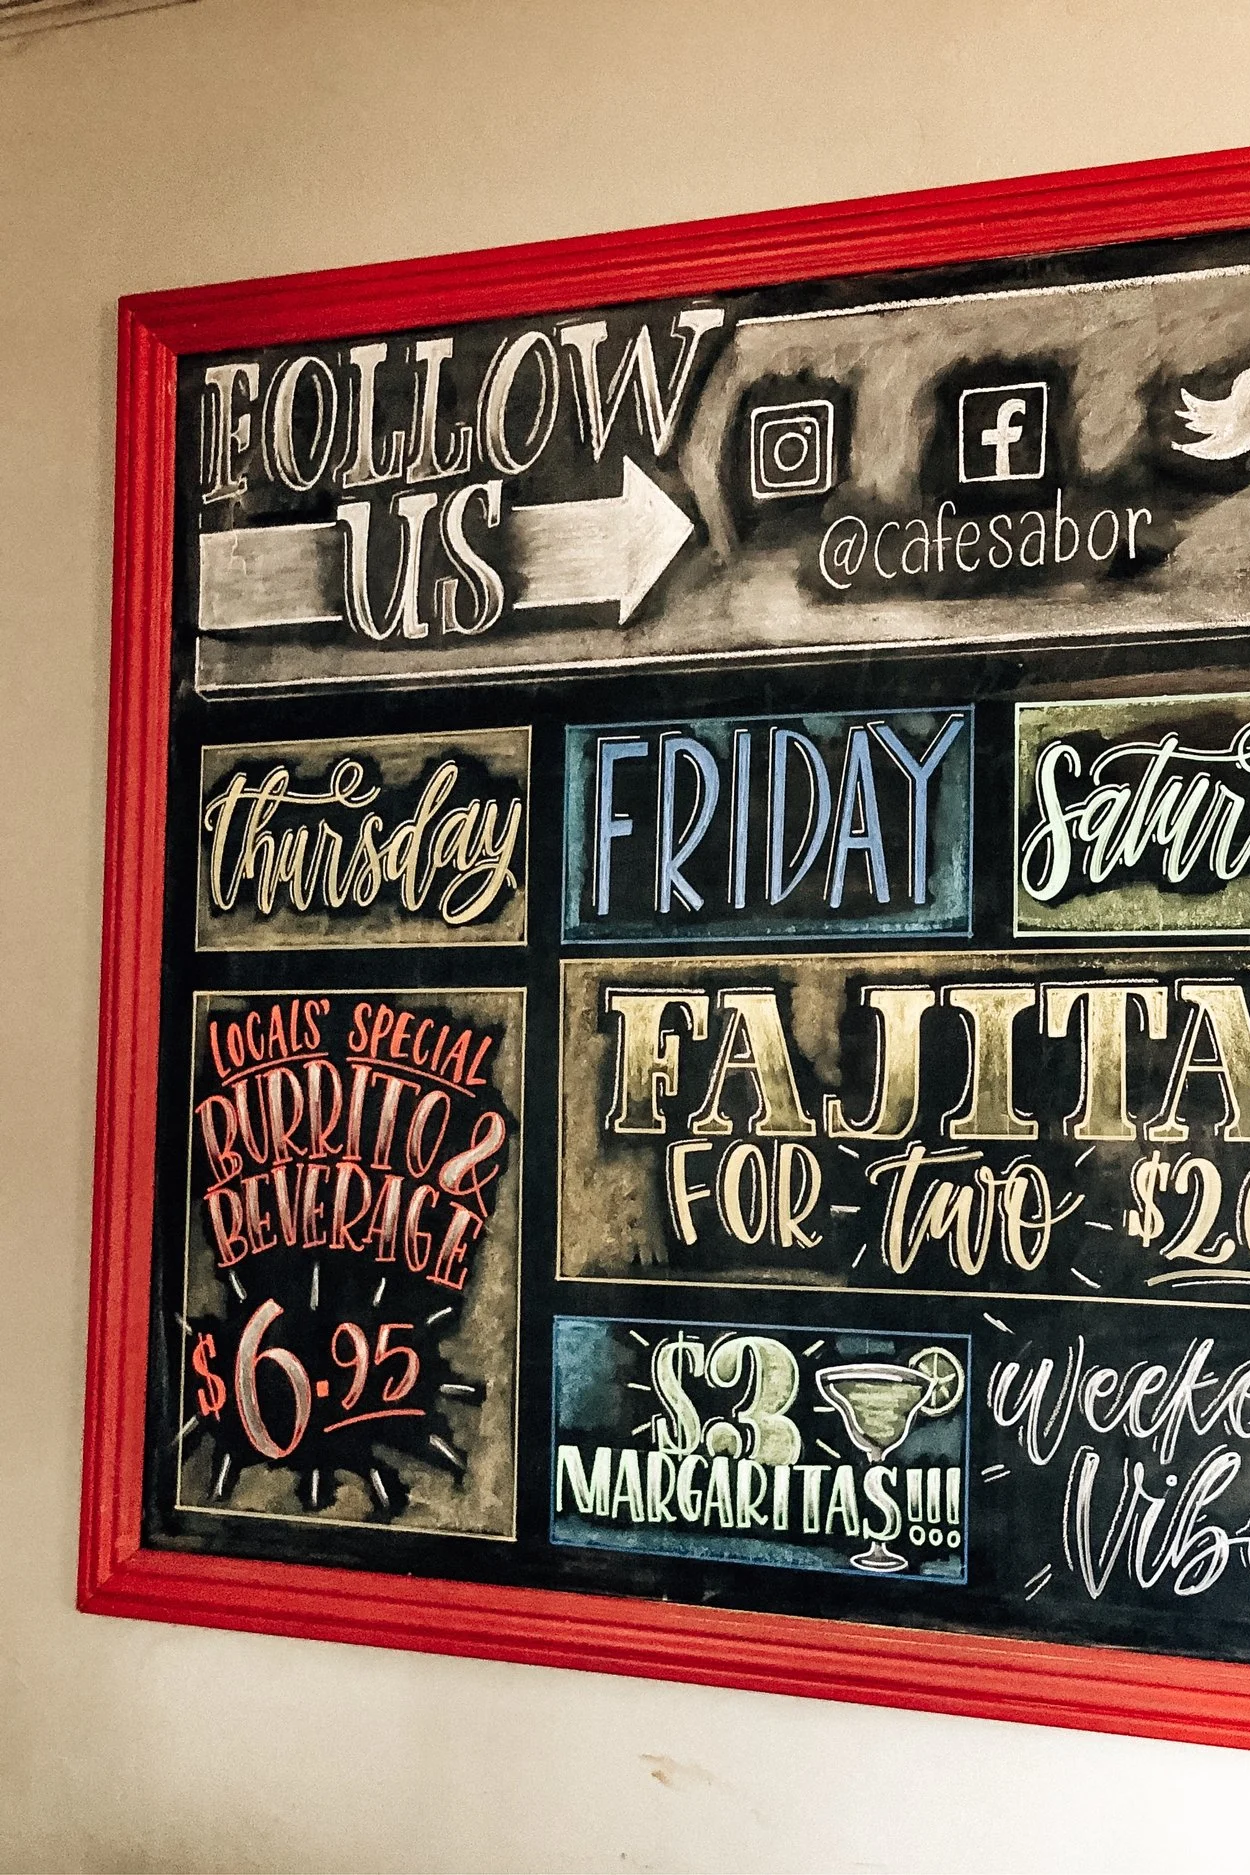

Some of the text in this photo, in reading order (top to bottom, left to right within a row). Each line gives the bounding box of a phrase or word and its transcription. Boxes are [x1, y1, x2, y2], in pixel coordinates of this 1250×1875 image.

[200, 308, 725, 503] FOLLOW
[335, 480, 505, 642] US
[818, 487, 1153, 589] @cafesabor
[592, 713, 966, 915] FRIDAY
[346, 1001, 494, 1087] SPECIAL
[194, 1060, 506, 1218] BURRITO &
[665, 1138, 825, 1249] FOR
[868, 1140, 1090, 1276] two
[203, 1158, 484, 1290] BEVERAGE
[650, 1328, 806, 1466] $3
[556, 1442, 963, 1550] MARGARITAS!!!
